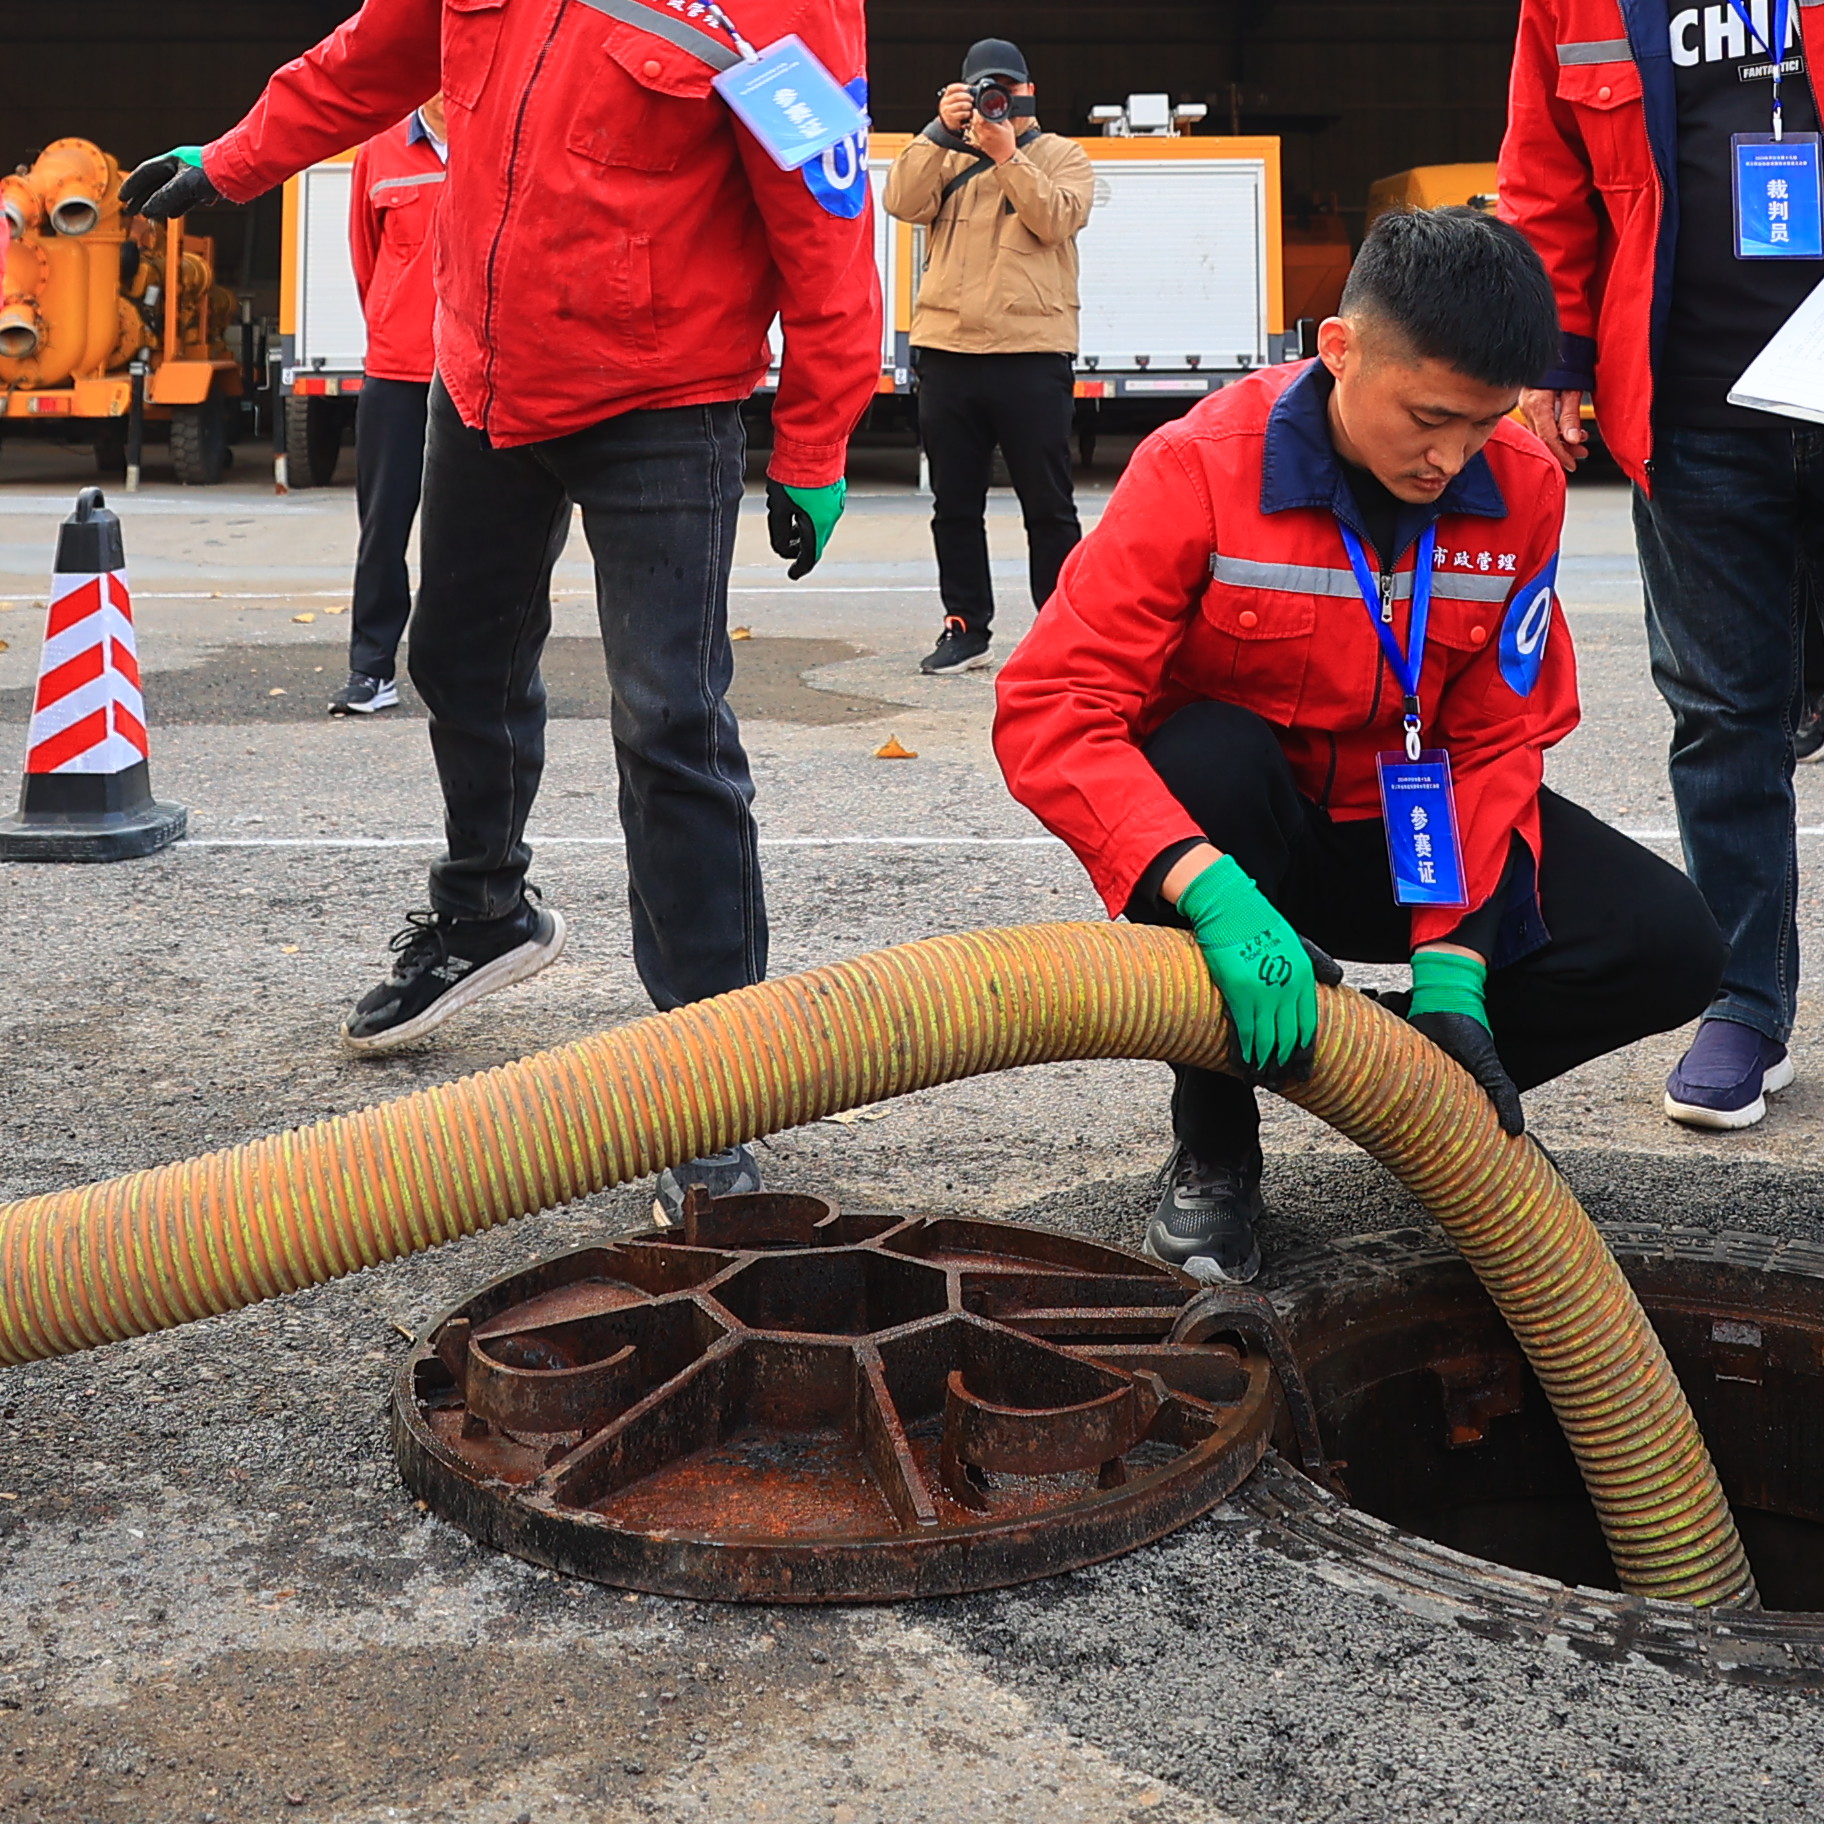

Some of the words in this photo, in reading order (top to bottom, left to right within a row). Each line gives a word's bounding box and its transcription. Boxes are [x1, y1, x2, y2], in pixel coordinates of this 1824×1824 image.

[1743, 59, 1800, 79] FANTATIC!
[1766, 178, 1790, 243] 裁判员
[1432, 545, 1518, 572] 市政管理
[1410, 805, 1437, 885] 参赛证
